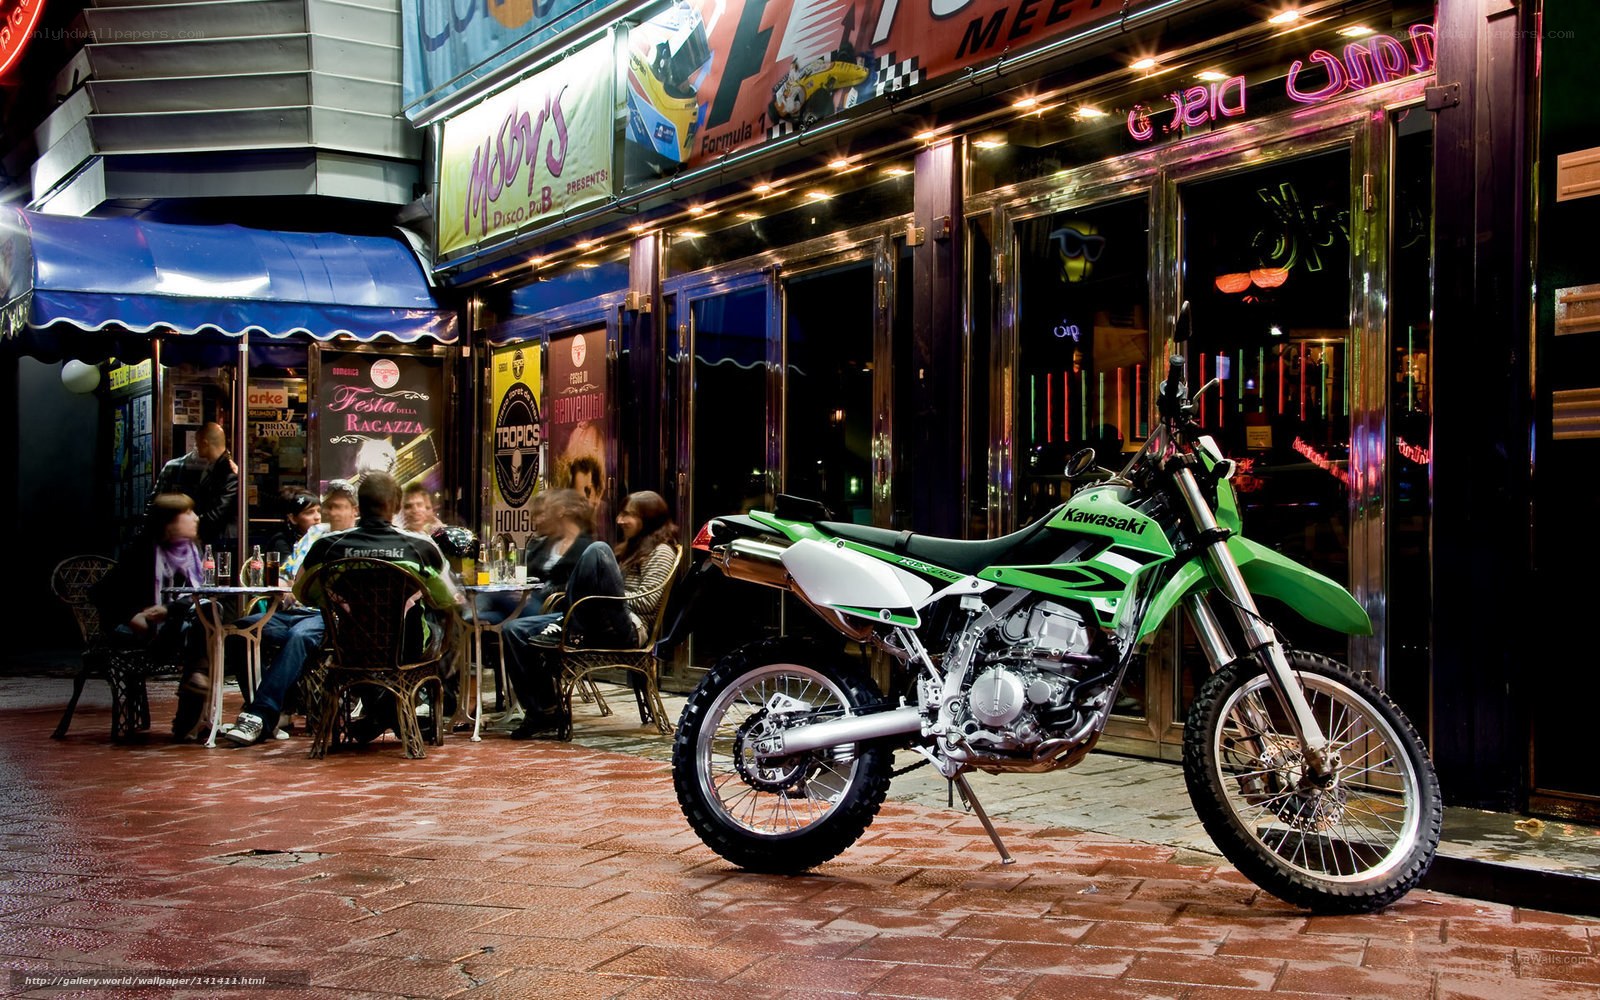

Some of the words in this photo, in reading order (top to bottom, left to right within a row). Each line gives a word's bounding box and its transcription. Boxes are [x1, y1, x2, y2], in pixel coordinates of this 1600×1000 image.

[954, 0, 1100, 60] MEE
[701, 120, 753, 158] Formula
[758, 112, 767, 135] 1
[567, 171, 608, 195] PRESENTS:
[249, 391, 283, 405] arke
[327, 384, 398, 414] Festa
[264, 430, 296, 438] VIAGGI
[346, 413, 424, 434] RAGAZZA
[496, 423, 540, 448] TROPICS
[1062, 508, 1148, 535] Kawasaki
[344, 547, 404, 559] Kawasaki
